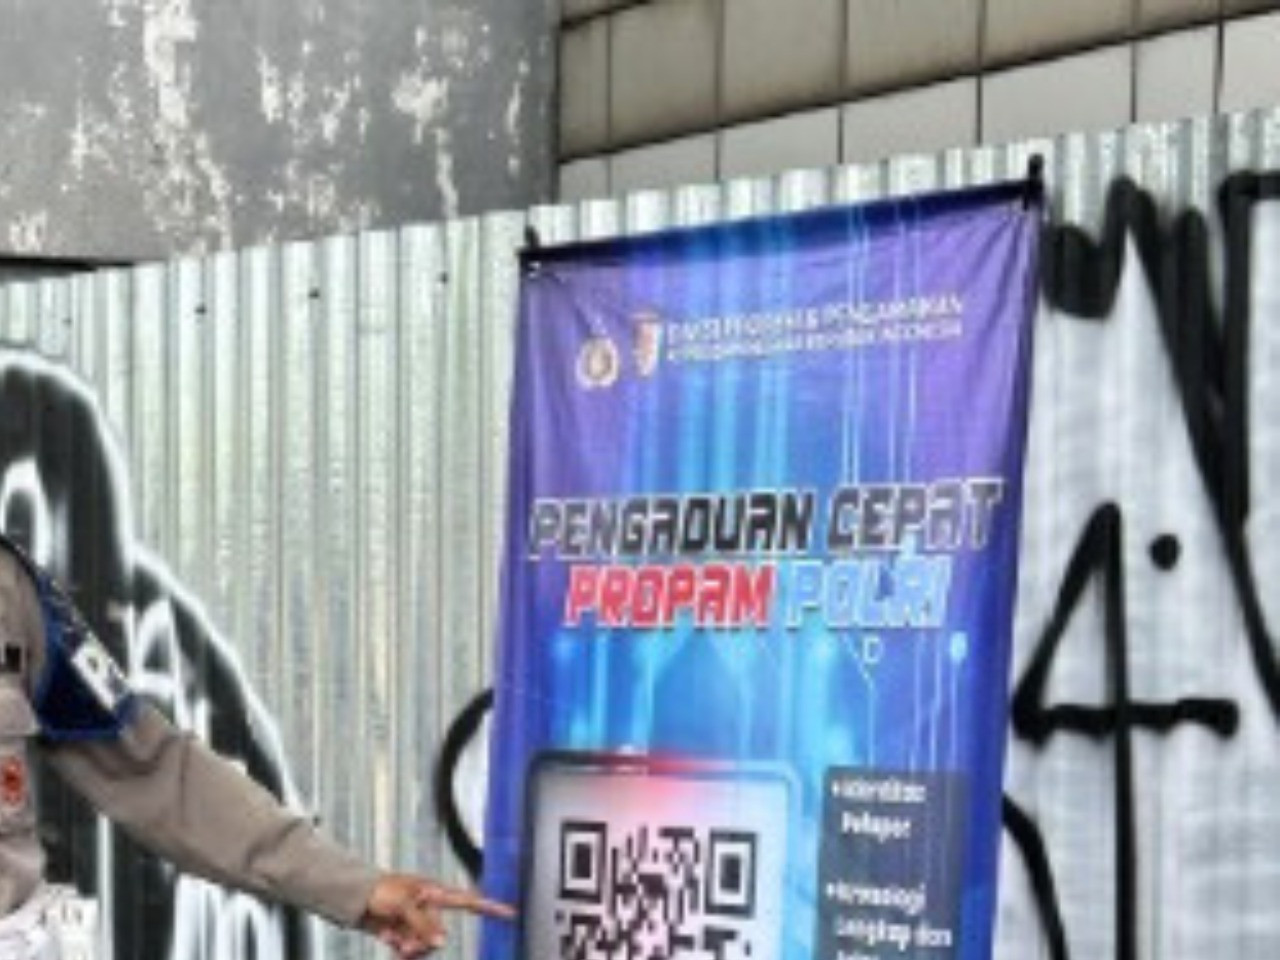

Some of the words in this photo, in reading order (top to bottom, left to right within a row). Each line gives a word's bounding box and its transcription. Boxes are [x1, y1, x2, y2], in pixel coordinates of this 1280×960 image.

[528, 488, 815, 560] PENGADUAN
[826, 477, 1005, 552] CEPAT
[563, 561, 776, 629] PROPAM
[784, 557, 951, 629] POLRI
